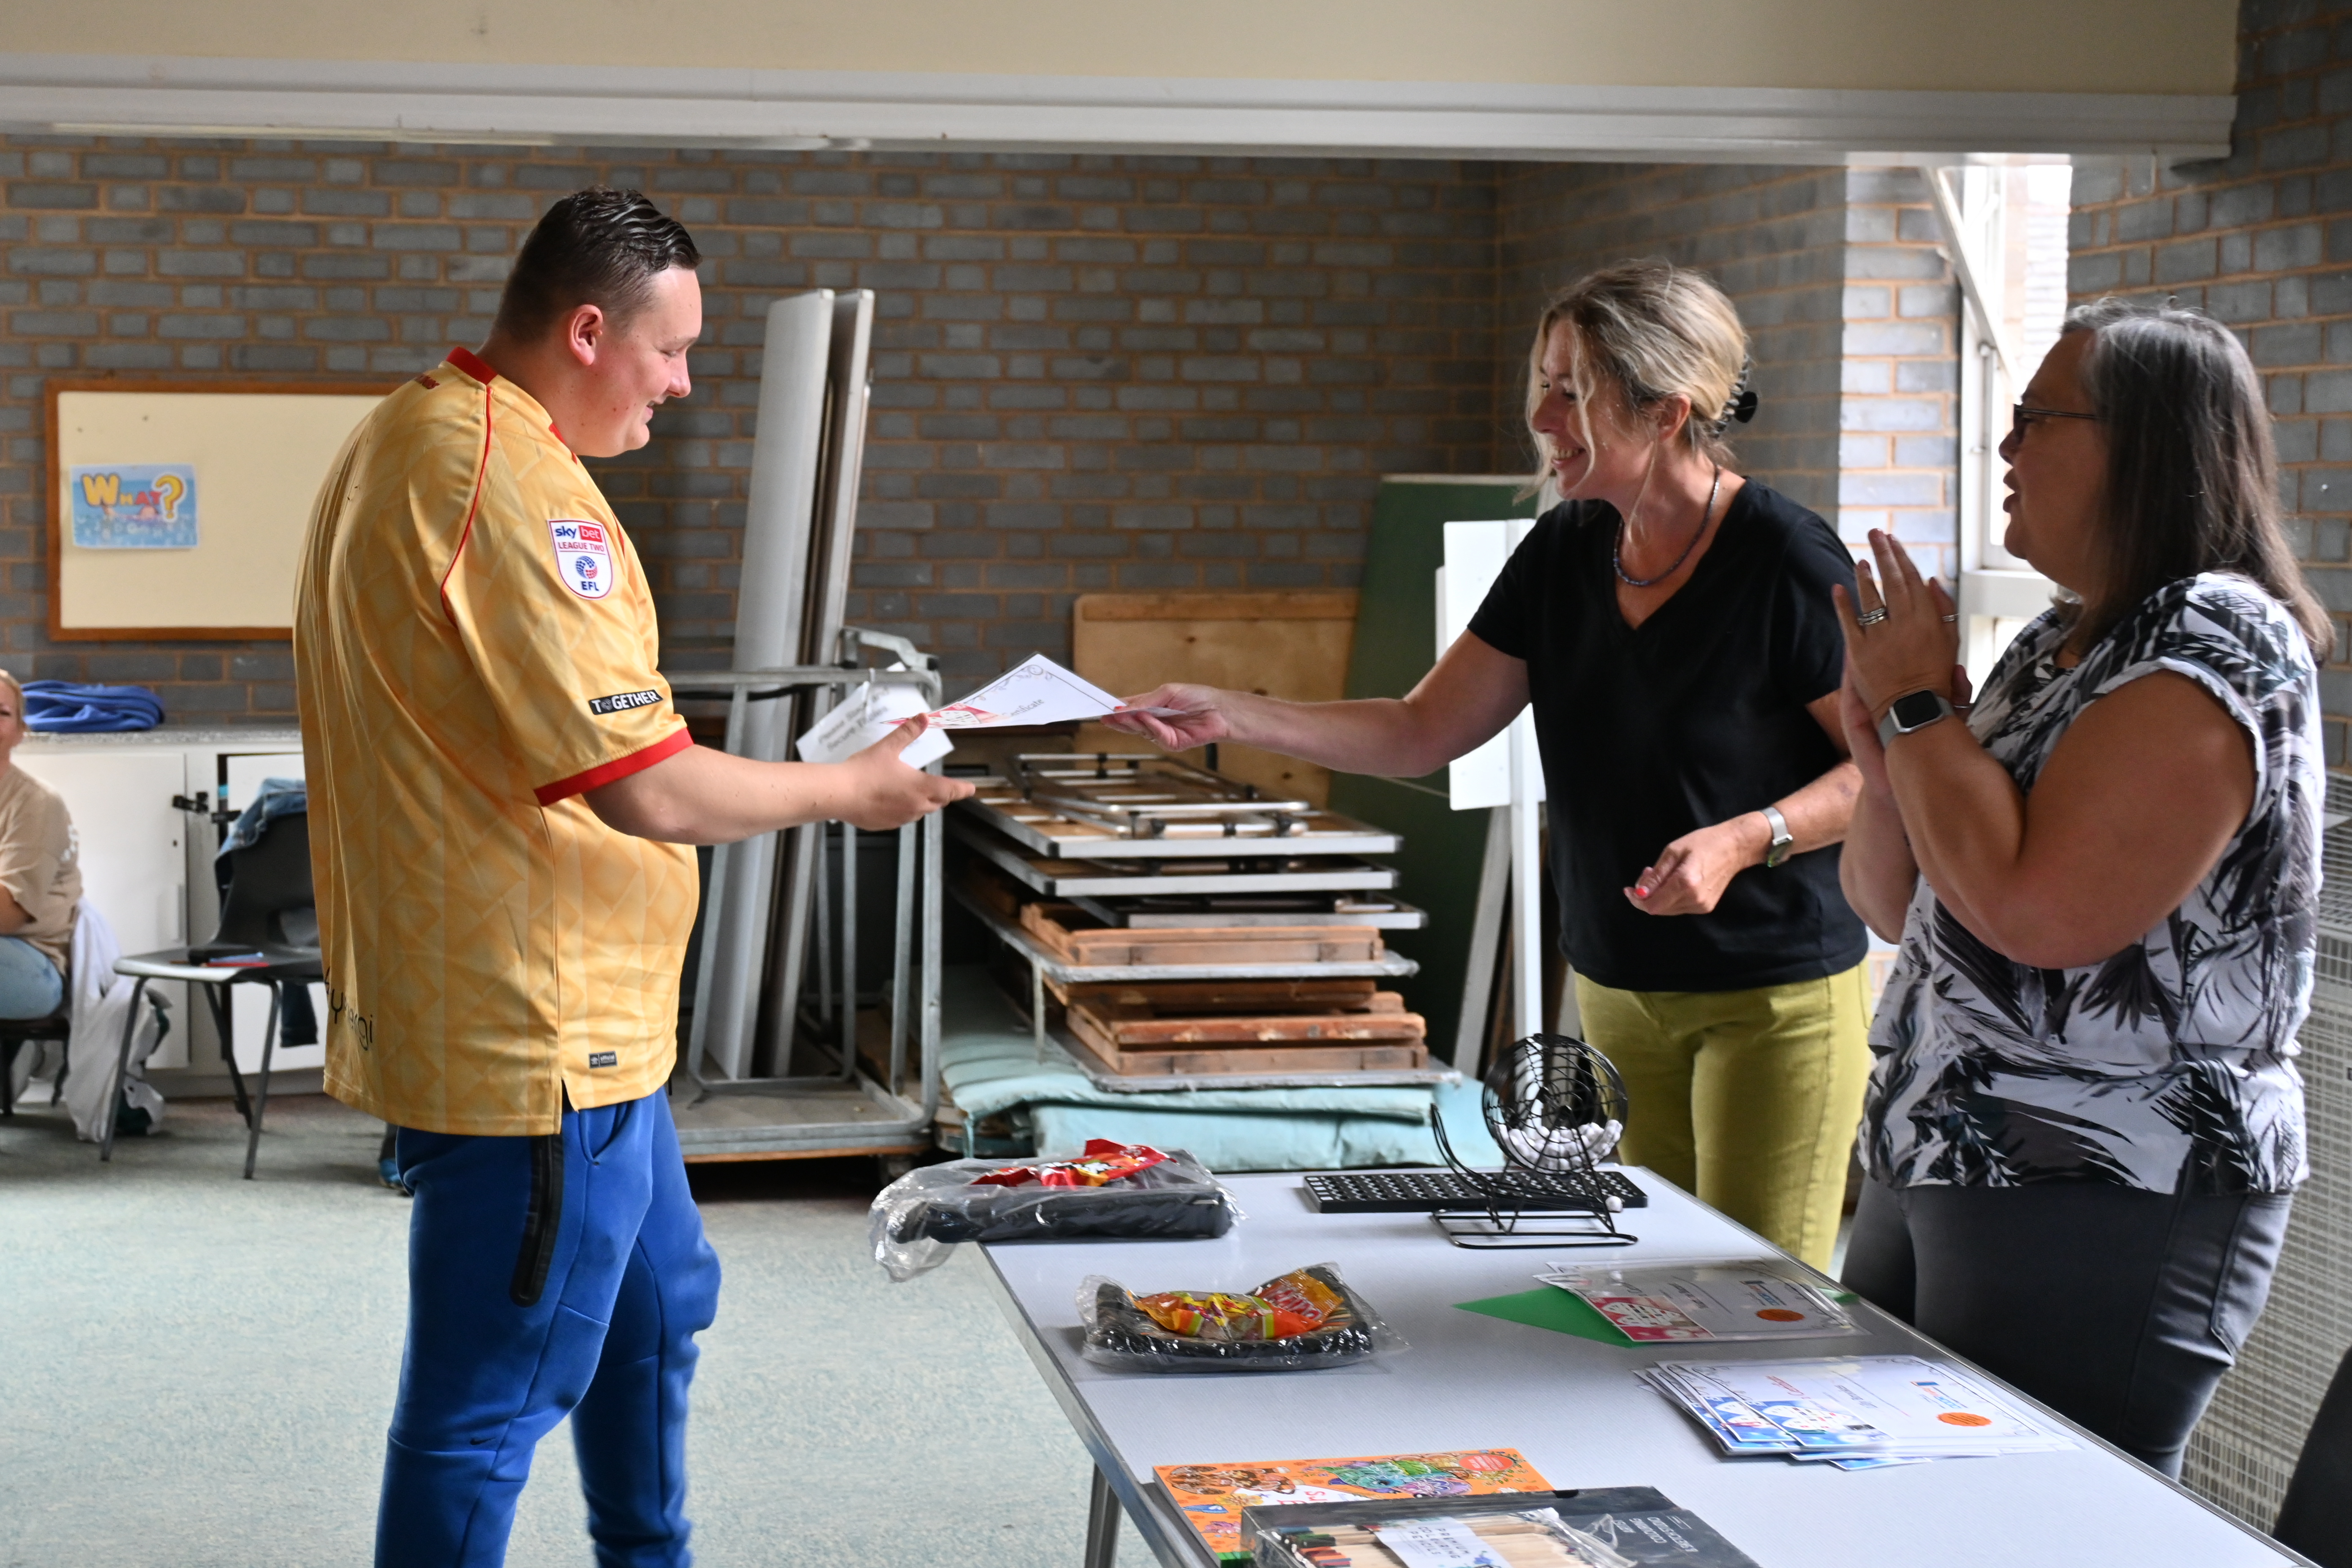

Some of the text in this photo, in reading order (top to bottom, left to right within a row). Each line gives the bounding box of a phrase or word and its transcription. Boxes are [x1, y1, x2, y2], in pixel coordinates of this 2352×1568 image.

[555, 526, 600, 539] sky bet
[558, 542, 604, 552] LEAGUE TWO
[581, 581, 599, 591] EFL
